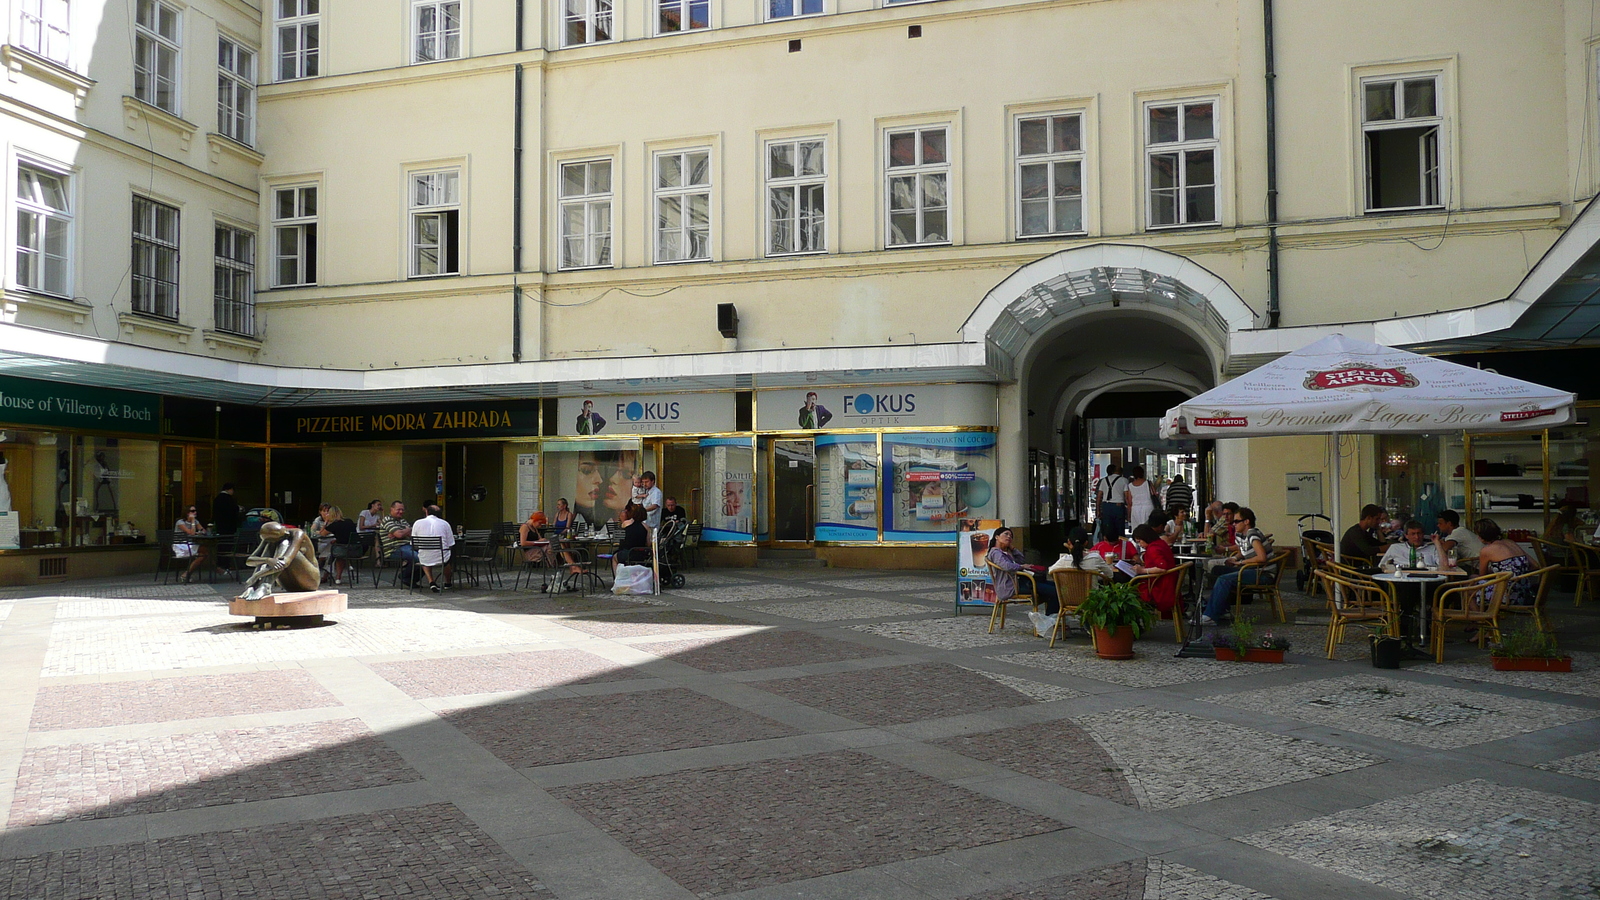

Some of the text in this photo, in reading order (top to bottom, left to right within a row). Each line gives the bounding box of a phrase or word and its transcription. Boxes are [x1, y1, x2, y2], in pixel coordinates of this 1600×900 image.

[1325, 370, 1394, 380] STELLA
[1328, 375, 1398, 386] ARTOIS
[38, 396, 53, 412] of
[56, 397, 105, 420] Villeroy
[108, 403, 119, 417] &
[123, 404, 151, 421] Boch
[616, 401, 680, 421] FOKUS
[843, 393, 916, 414] FOKUS
[297, 410, 512, 433] PIZZERIE MODRÁ ZAHRADA
[1257, 402, 1492, 428] Premium Lager Beer
[632, 423, 666, 431] OPTIK
[926, 436, 966, 444] KONTAKTNÍ
[726, 472, 752, 480] DAILIE
